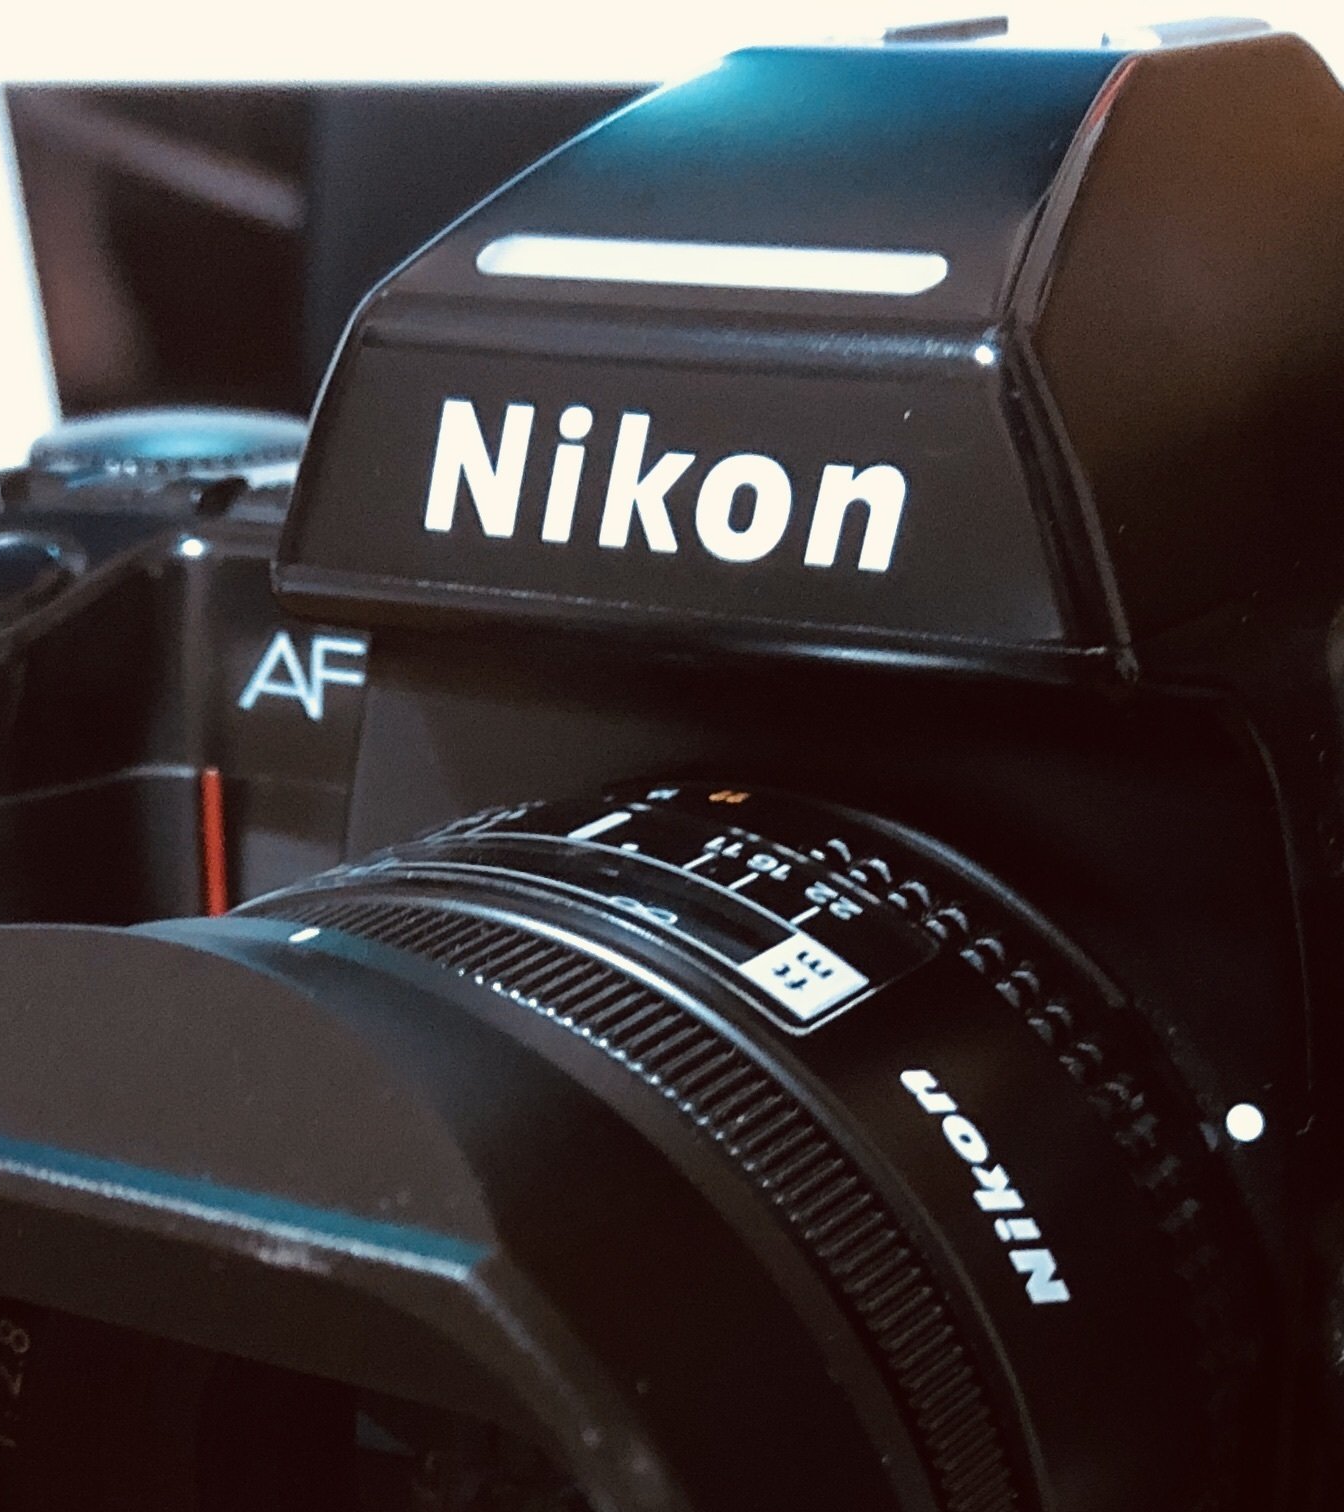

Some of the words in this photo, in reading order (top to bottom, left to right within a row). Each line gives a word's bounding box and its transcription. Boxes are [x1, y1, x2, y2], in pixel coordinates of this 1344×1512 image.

[425, 399, 907, 572] Nikon
[238, 632, 369, 720] AF
[746, 853, 792, 882] 16
[805, 881, 864, 920] 22
[900, 1069, 1071, 1304] Nikon
